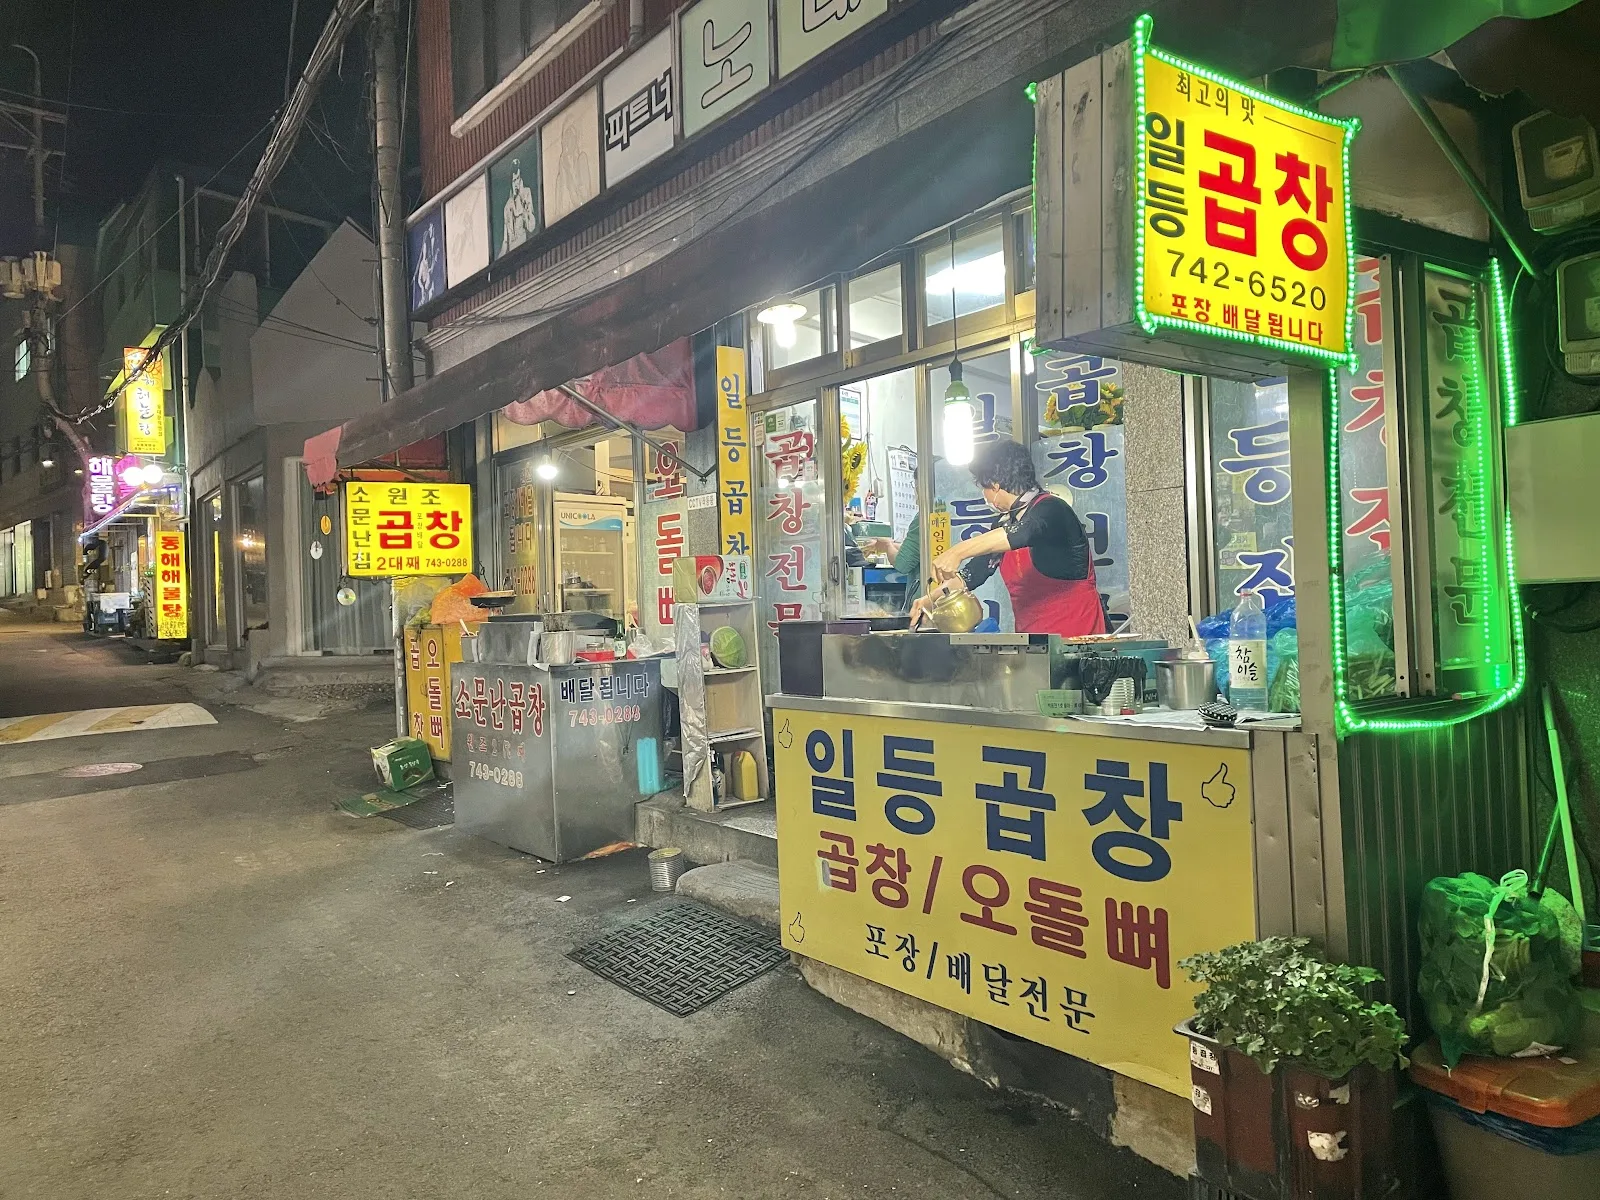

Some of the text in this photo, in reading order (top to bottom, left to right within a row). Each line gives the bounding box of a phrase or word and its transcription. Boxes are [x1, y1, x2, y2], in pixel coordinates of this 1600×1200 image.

[1176, 72, 1256, 126] 최고의 맛
[1145, 111, 1189, 239] 일등
[1198, 128, 1334, 273] 곱창
[1167, 248, 1327, 312] 742-6520
[1170, 293, 1325, 346] 포장 배달됩니다
[88, 457, 116, 514] 해물탕
[350, 486, 371, 570] 소문난집
[376, 510, 463, 549] 곱창
[161, 536, 182, 618] 동해해물탕
[376, 556, 468, 571] 2대째 743-0288
[426, 638, 445, 749] 오돌뼈
[454, 676, 546, 738] 소문난곱창
[560, 673, 650, 704] 배달됩니다
[567, 704, 642, 728] 743-0288
[468, 760, 524, 789] 743-0288
